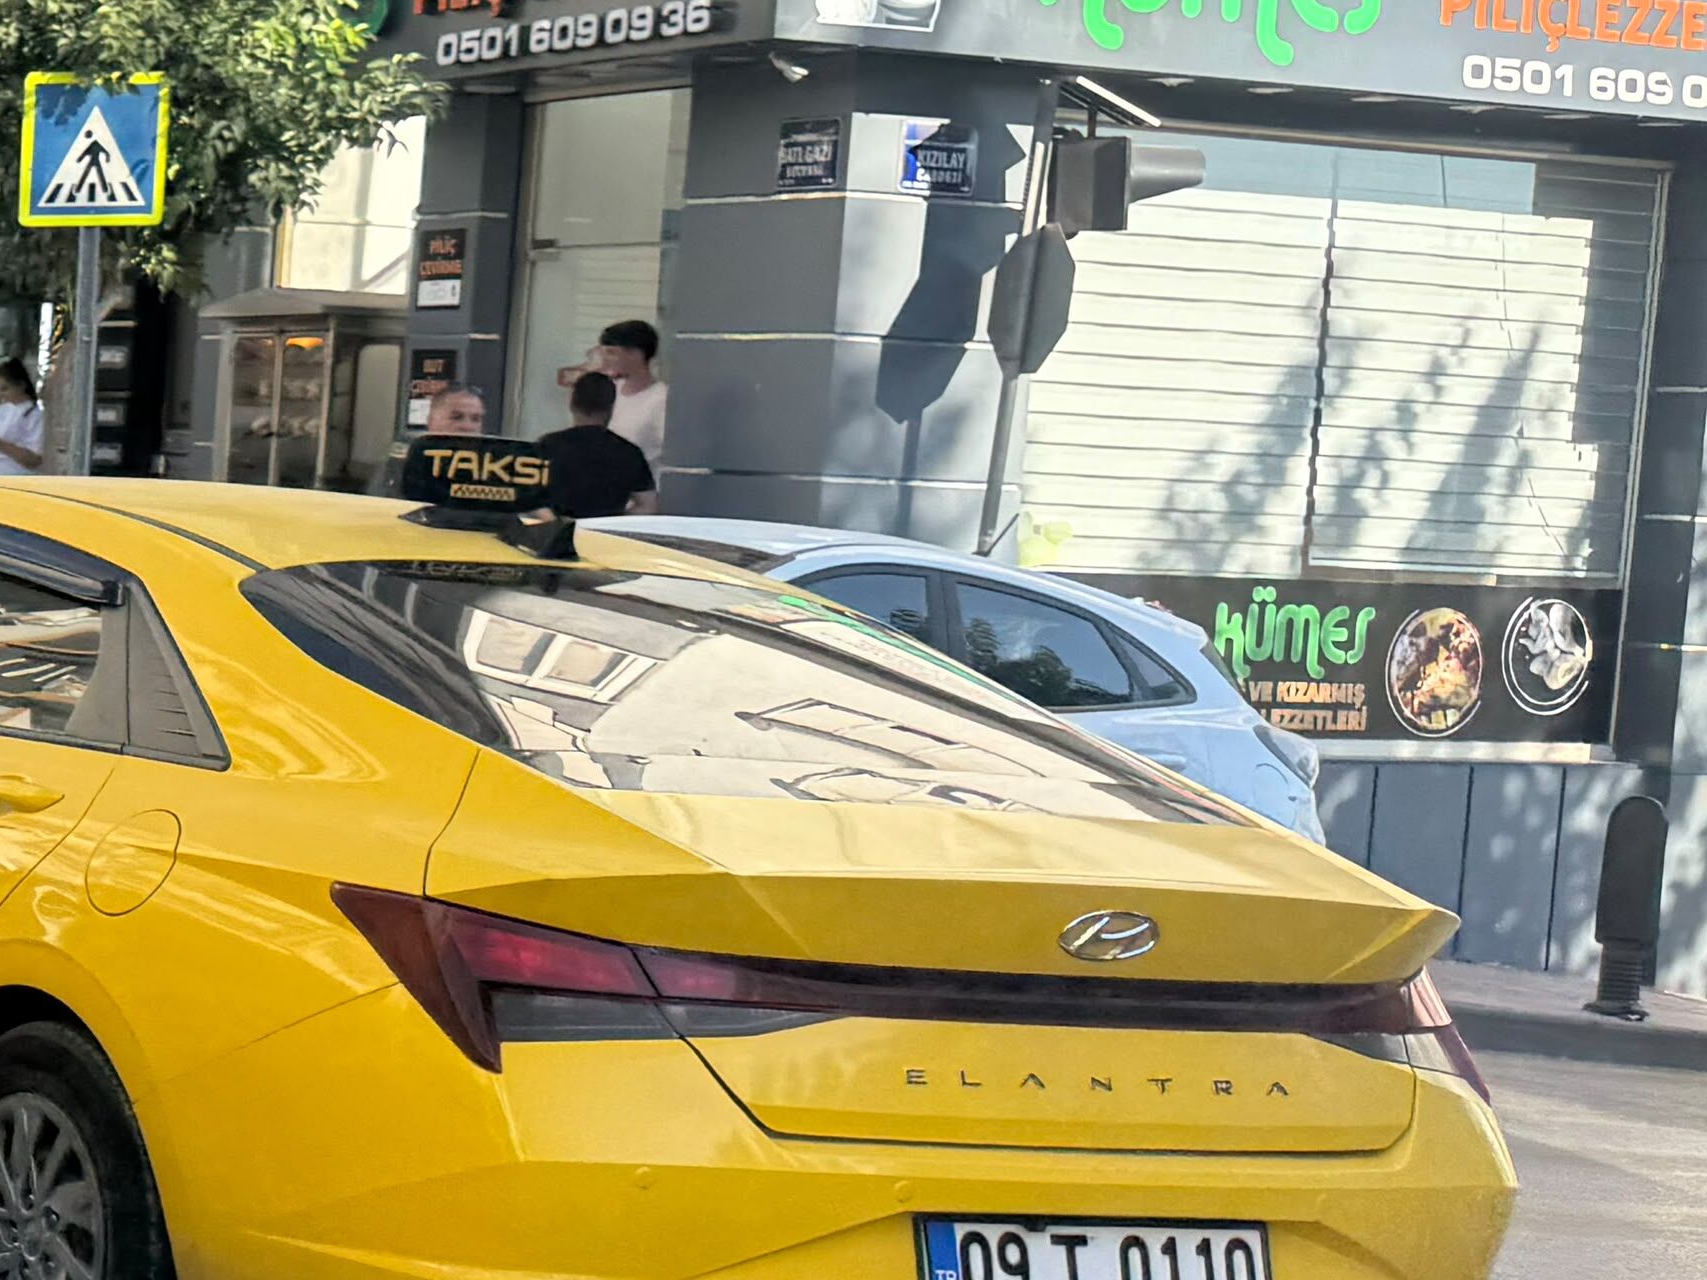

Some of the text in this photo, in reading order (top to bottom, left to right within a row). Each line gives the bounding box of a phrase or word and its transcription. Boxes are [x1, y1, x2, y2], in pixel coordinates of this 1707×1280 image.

[436, 29, 521, 66] 0501
[529, 13, 599, 53] 609
[603, 5, 654, 44] 09
[1462, 54, 1707, 109] 0501 609 0
[917, 149, 966, 169] KIZILAY
[1249, 681, 1274, 703] VE
[1277, 681, 1365, 709] KIZARMIŞ
[905, 1068, 1290, 1097] ELANTRA
